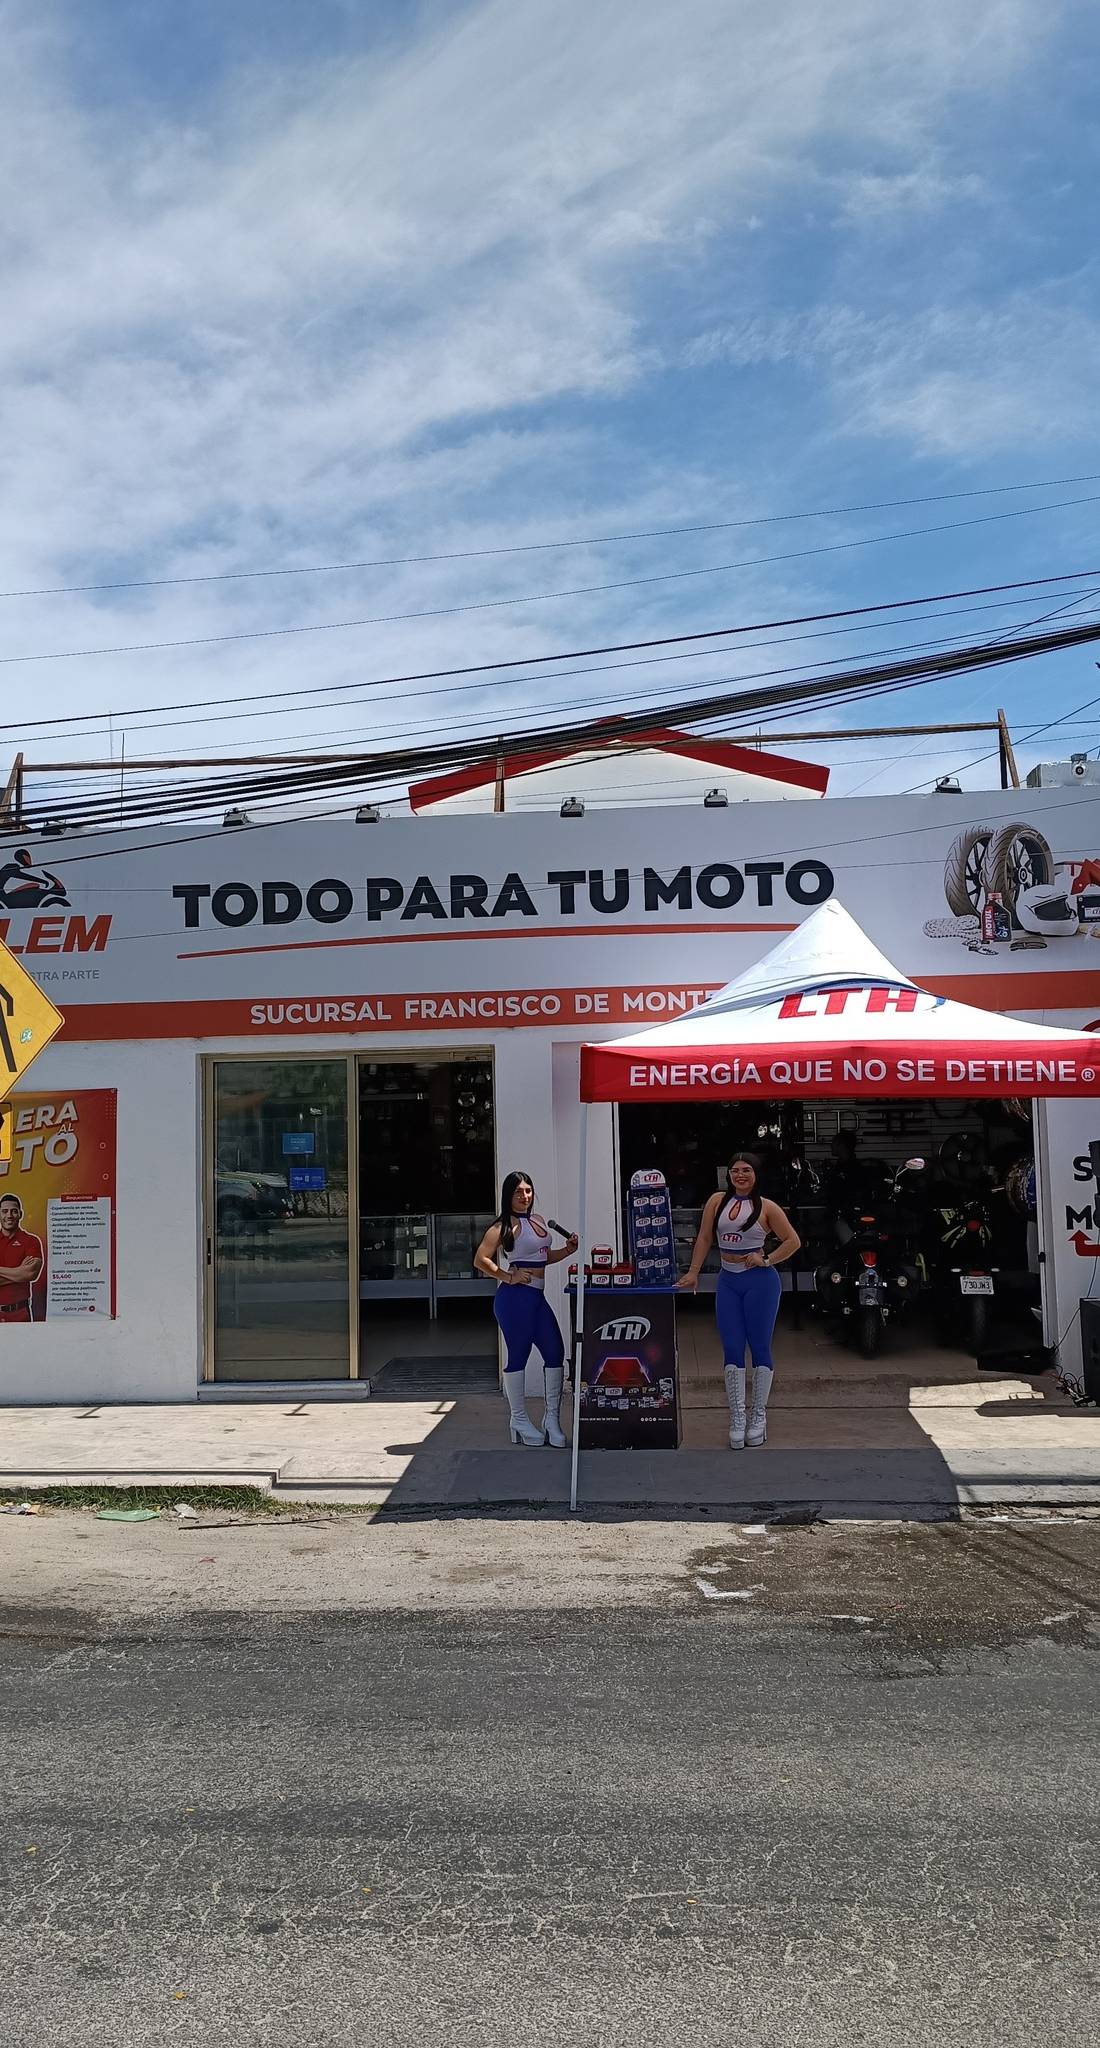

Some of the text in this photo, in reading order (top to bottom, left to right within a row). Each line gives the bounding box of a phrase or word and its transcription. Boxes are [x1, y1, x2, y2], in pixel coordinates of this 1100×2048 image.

[172, 859, 835, 928] TODO PARA TU MOTO
[62, 969, 101, 980] PARTE
[250, 1001, 392, 1026] SUCURSAL
[404, 994, 561, 1020] FRANCISCO
[574, 992, 610, 1015] DE
[777, 986, 919, 1020] LTH
[629, 1059, 762, 1087] ENERGÍA
[769, 1060, 833, 1085] QUE
[843, 1059, 887, 1082] NO
[896, 1059, 936, 1082] SE
[58, 1123, 74, 1134] AL
[643, 1174, 659, 1183] LTH
[1073, 1156, 1094, 1181] S
[722, 1233, 739, 1243] LTH
[600, 1323, 642, 1341] LTH
